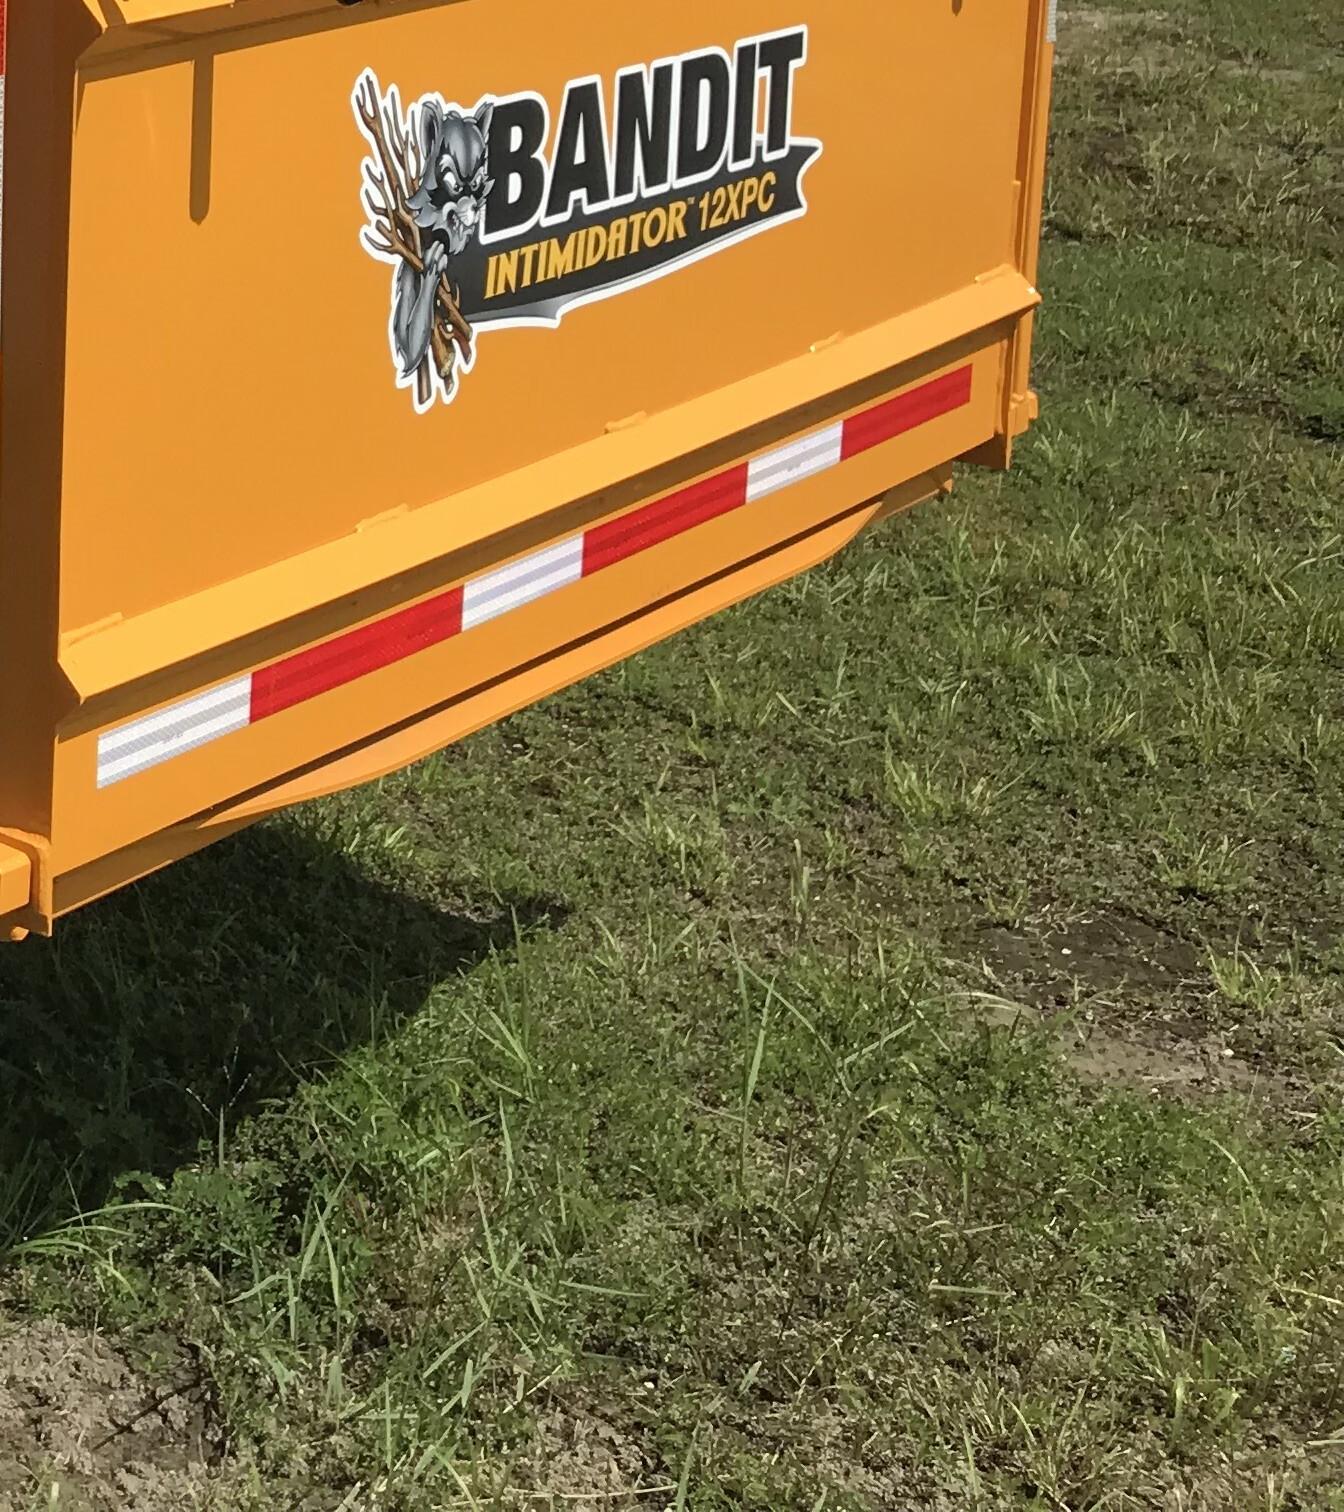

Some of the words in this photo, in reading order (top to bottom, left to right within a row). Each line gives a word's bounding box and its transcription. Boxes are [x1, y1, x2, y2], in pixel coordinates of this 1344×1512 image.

[485, 31, 804, 236] BANDIT
[483, 206, 687, 300] INTIMIDATOR
[698, 172, 776, 232] 12XPC
